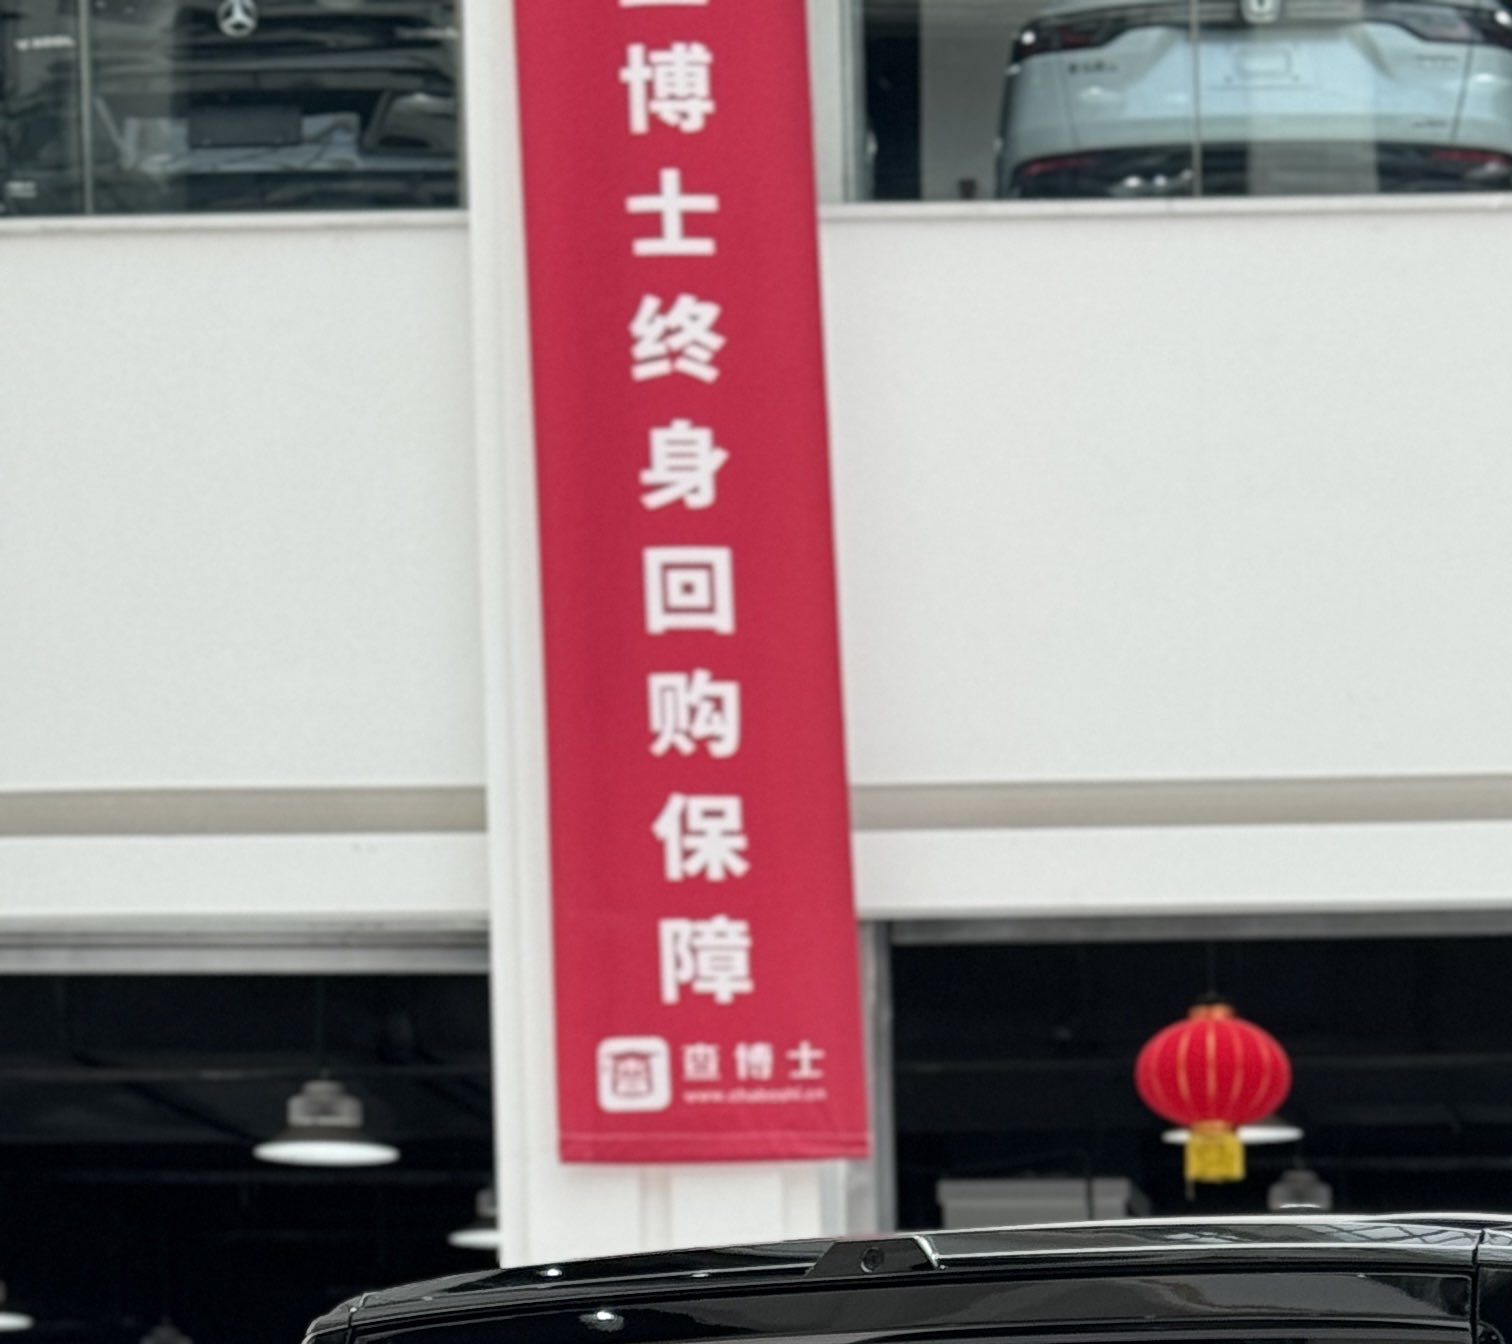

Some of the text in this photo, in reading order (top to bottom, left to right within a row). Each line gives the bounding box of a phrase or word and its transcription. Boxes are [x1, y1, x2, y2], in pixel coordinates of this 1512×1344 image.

[617, 0, 755, 1005] 博士终身回购保障
